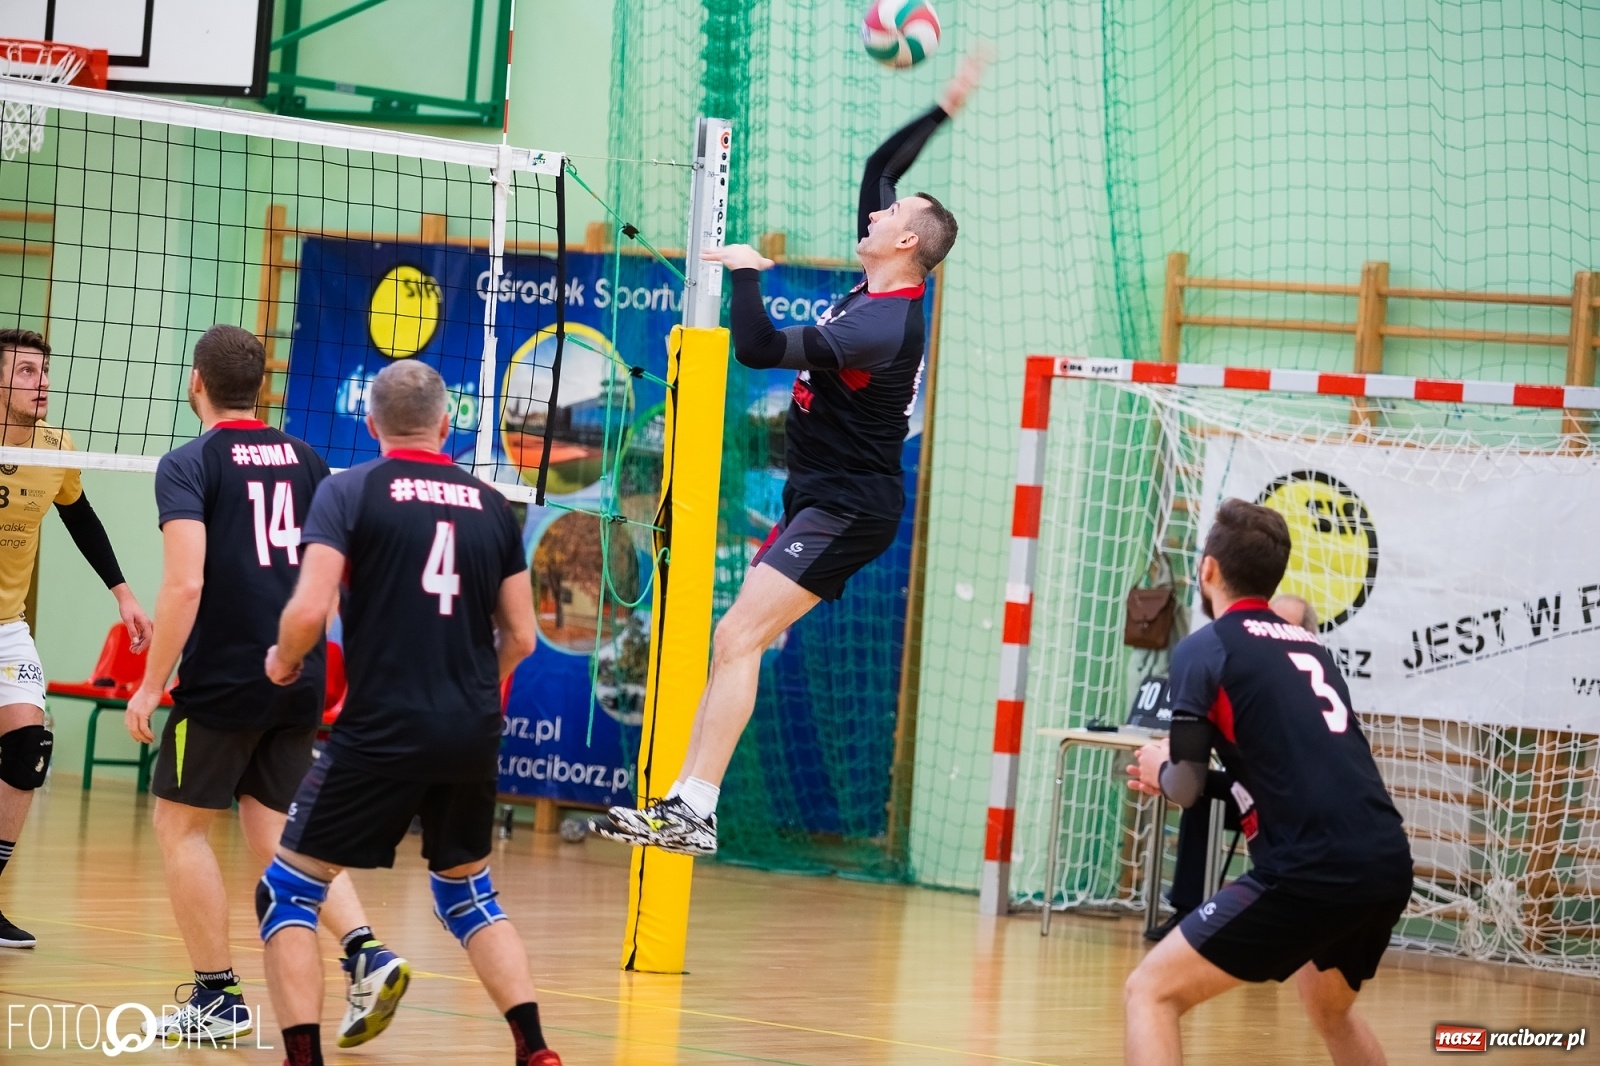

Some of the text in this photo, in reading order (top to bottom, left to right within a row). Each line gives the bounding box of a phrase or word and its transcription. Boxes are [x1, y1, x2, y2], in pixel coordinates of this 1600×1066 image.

[231, 443, 299, 466] #GUMA
[0, 539, 26, 549] ange
[247, 481, 302, 567] 14
[421, 521, 461, 616] 4
[1403, 606, 1509, 669] JEST
[1523, 591, 1561, 637] W
[1137, 680, 1161, 710] 10
[1288, 652, 1348, 733] 3
[501, 715, 562, 746] orz.pl
[498, 754, 636, 794] .raciborz.pl
